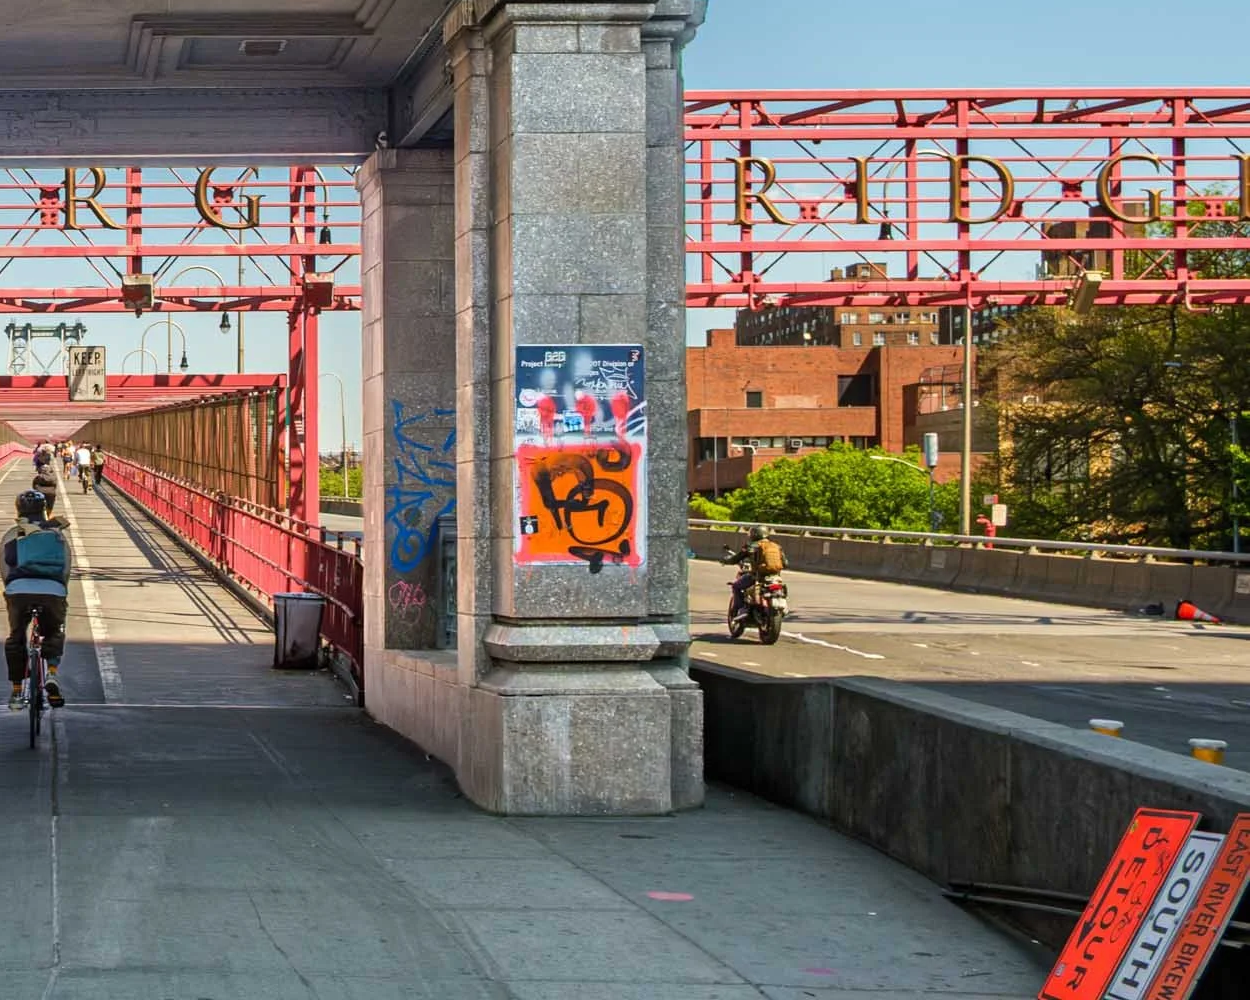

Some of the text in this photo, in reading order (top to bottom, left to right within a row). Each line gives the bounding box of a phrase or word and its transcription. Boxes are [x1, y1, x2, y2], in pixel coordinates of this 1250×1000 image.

[74, 352, 101, 365] KEEP
[521, 361, 544, 369] Project
[1066, 827, 1163, 991] DETOUR
[1121, 849, 1206, 988] SOUTH
[1190, 881, 1231, 937] RIVER
[1155, 943, 1199, 1000] BIKEW
